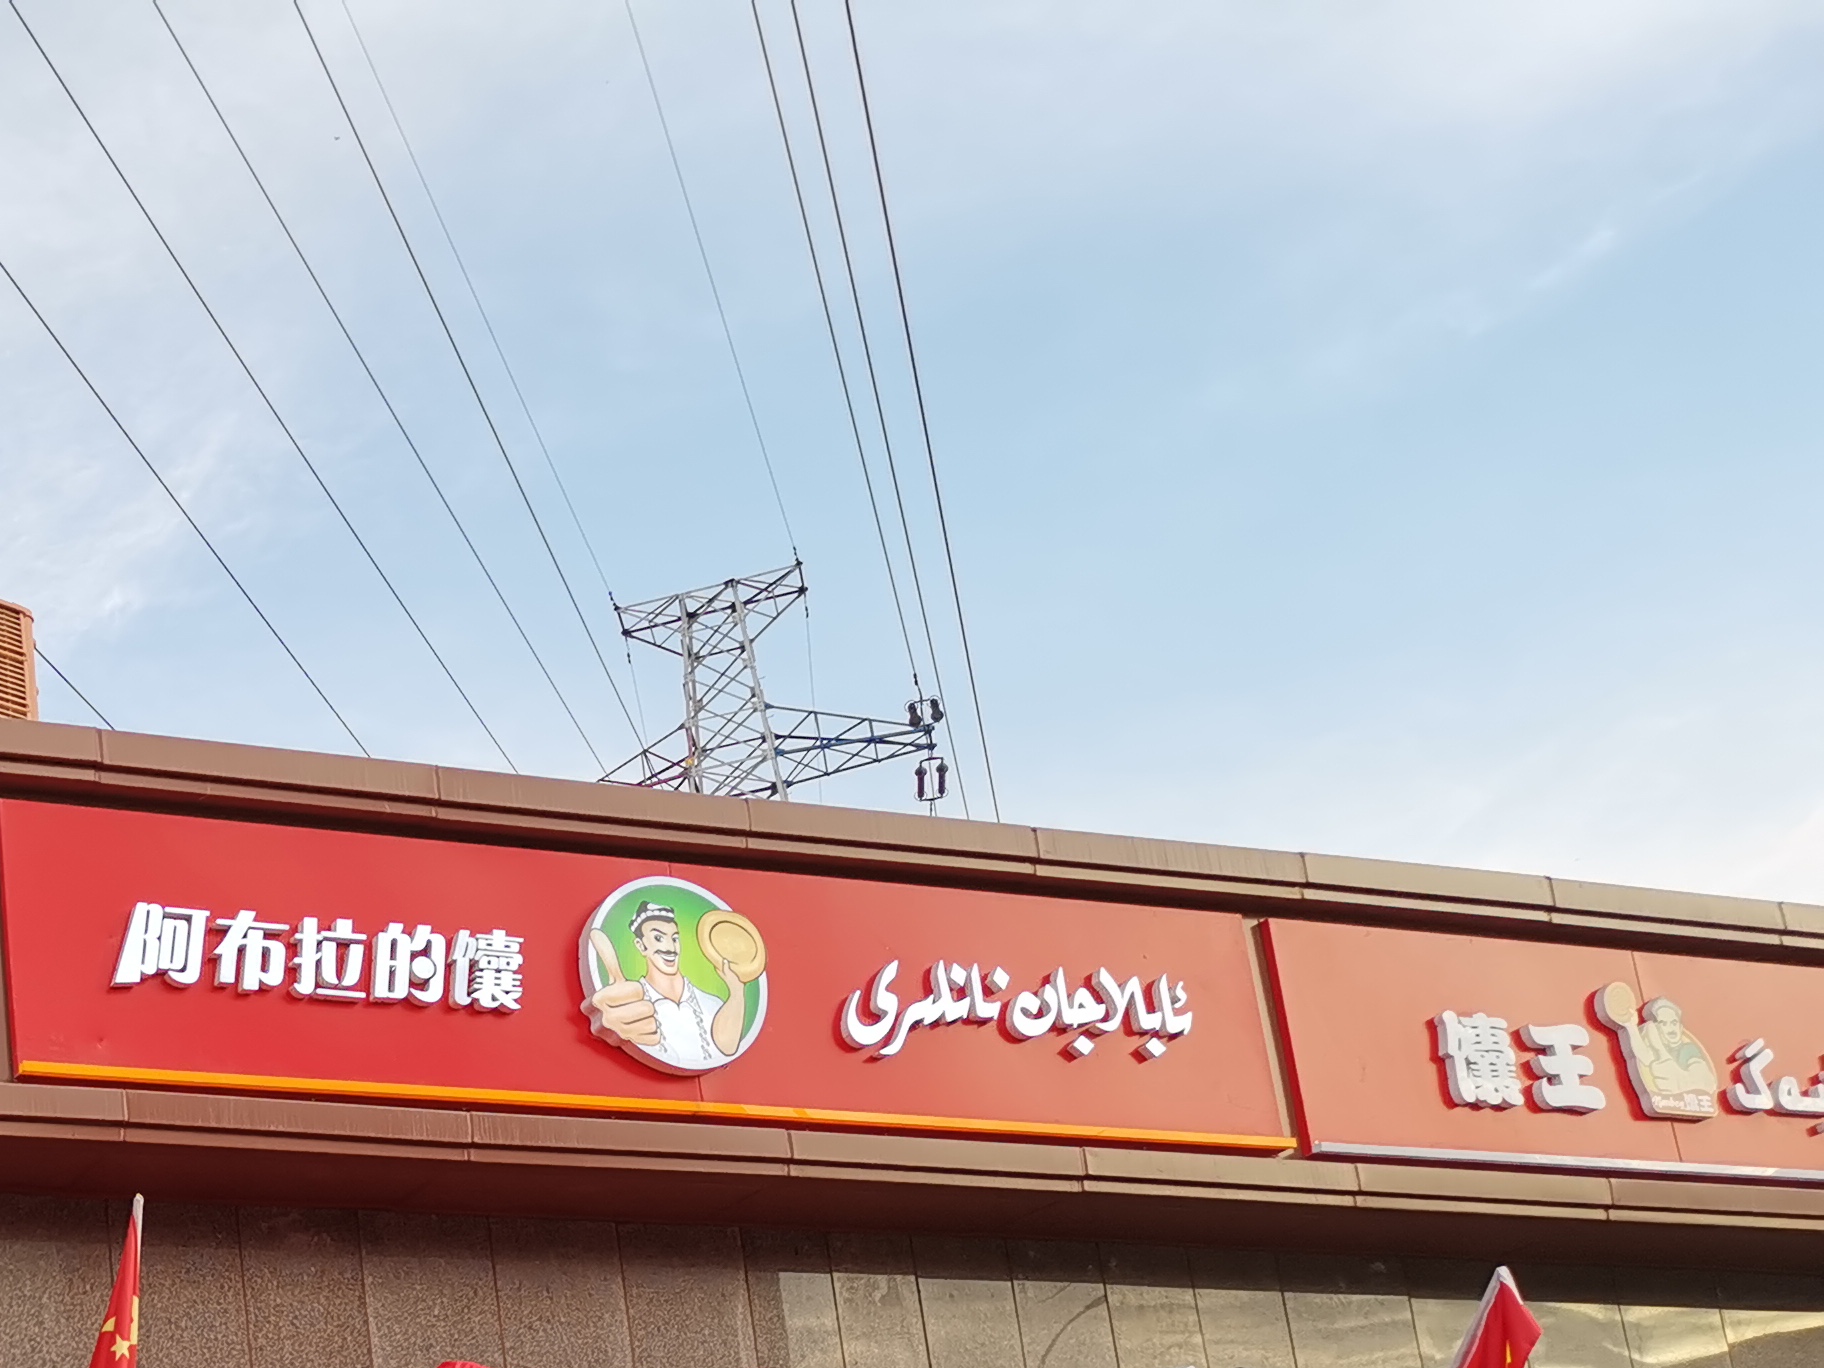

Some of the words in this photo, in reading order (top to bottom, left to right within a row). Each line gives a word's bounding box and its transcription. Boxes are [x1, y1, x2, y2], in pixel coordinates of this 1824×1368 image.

[111, 900, 525, 1012] 阿布拉的馕
[1434, 1009, 1606, 1114] 馕王
